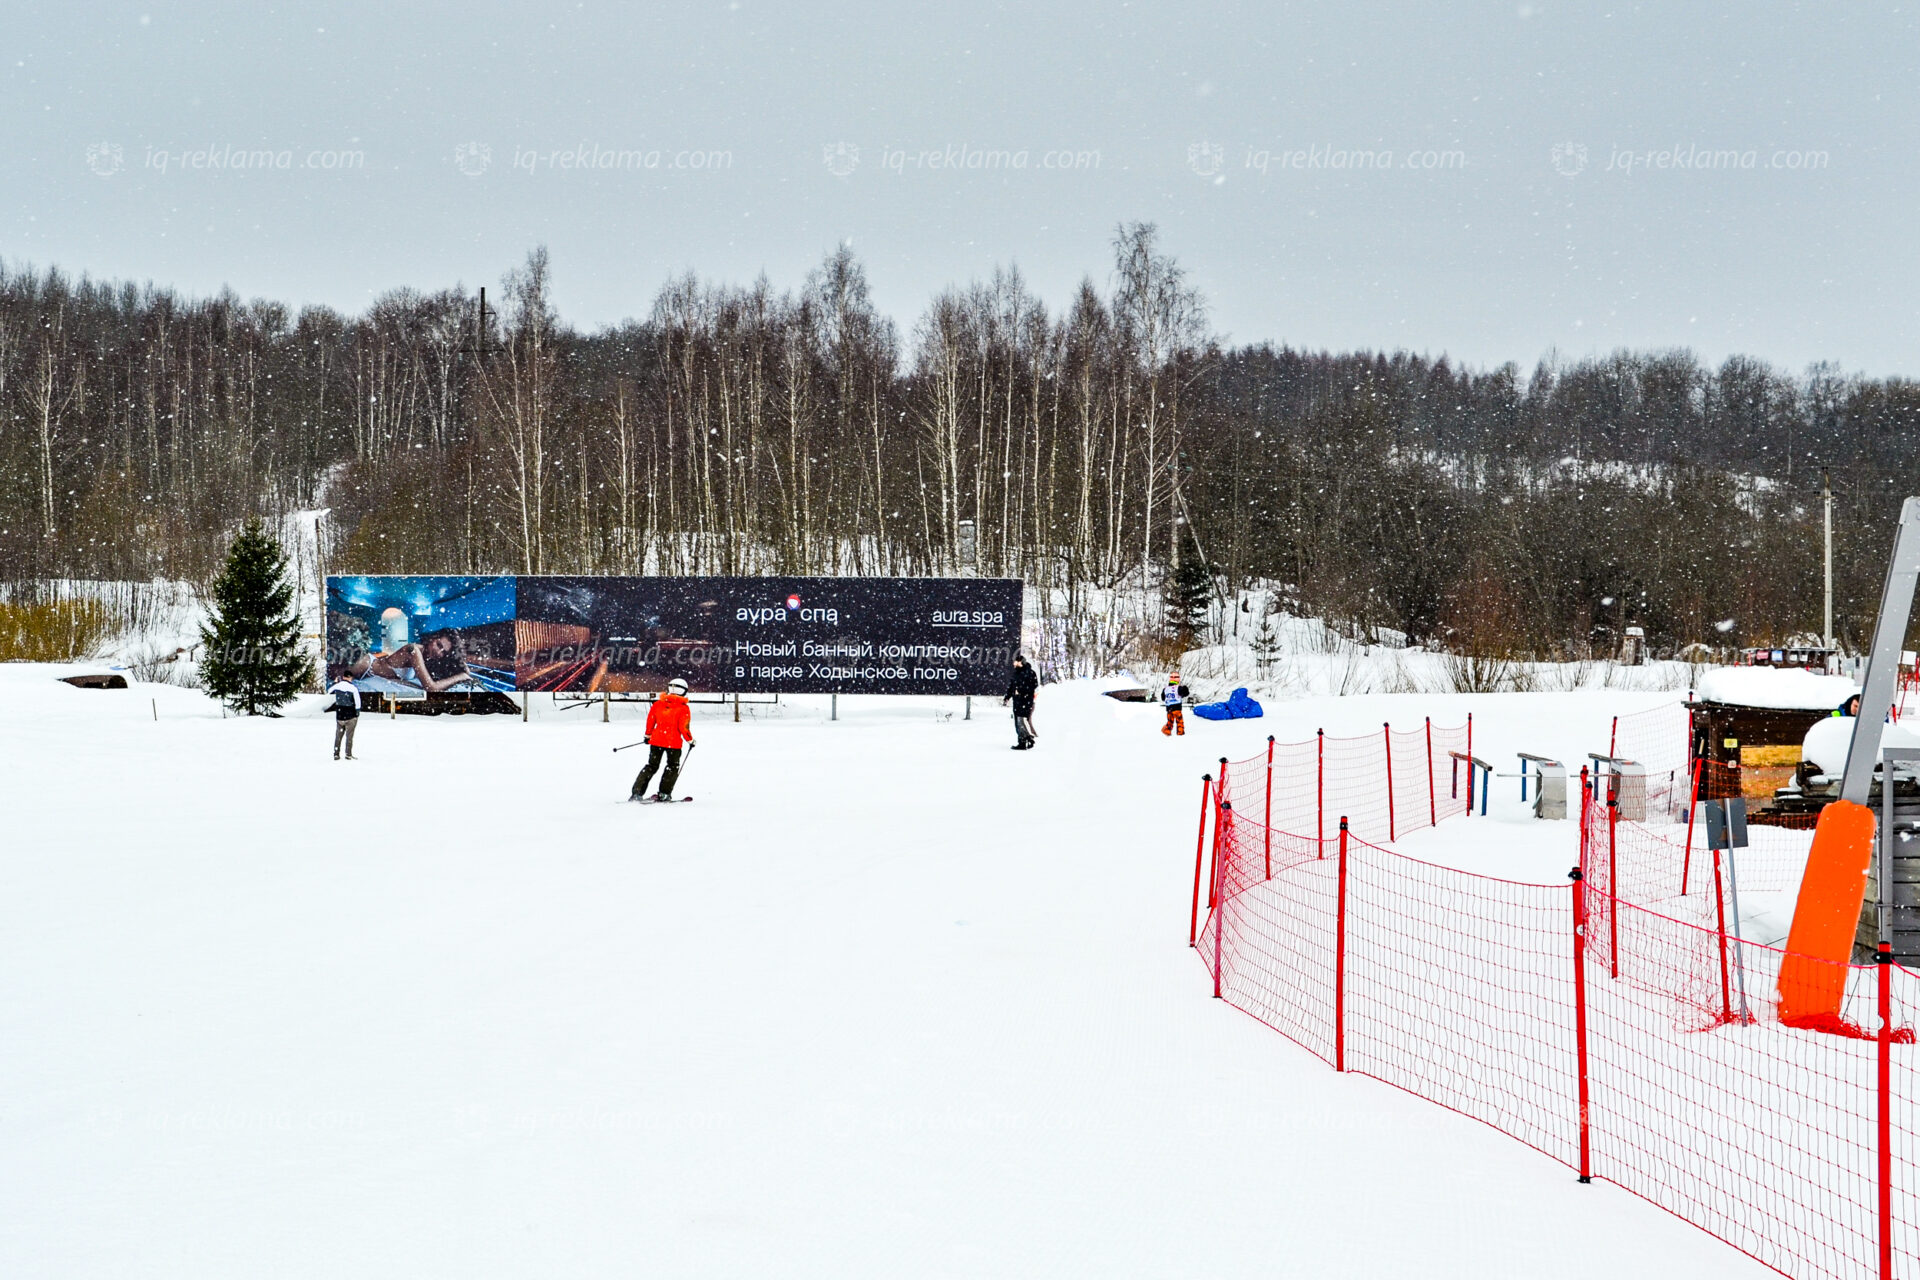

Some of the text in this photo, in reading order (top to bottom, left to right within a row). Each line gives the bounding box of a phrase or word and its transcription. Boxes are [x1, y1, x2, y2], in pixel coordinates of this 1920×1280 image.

[736, 607, 838, 625] аура спа
[932, 610, 1003, 626] aura.spa
[735, 640, 971, 658] Новый банный комплекс
[735, 663, 958, 681] в парке Ходынское поле
